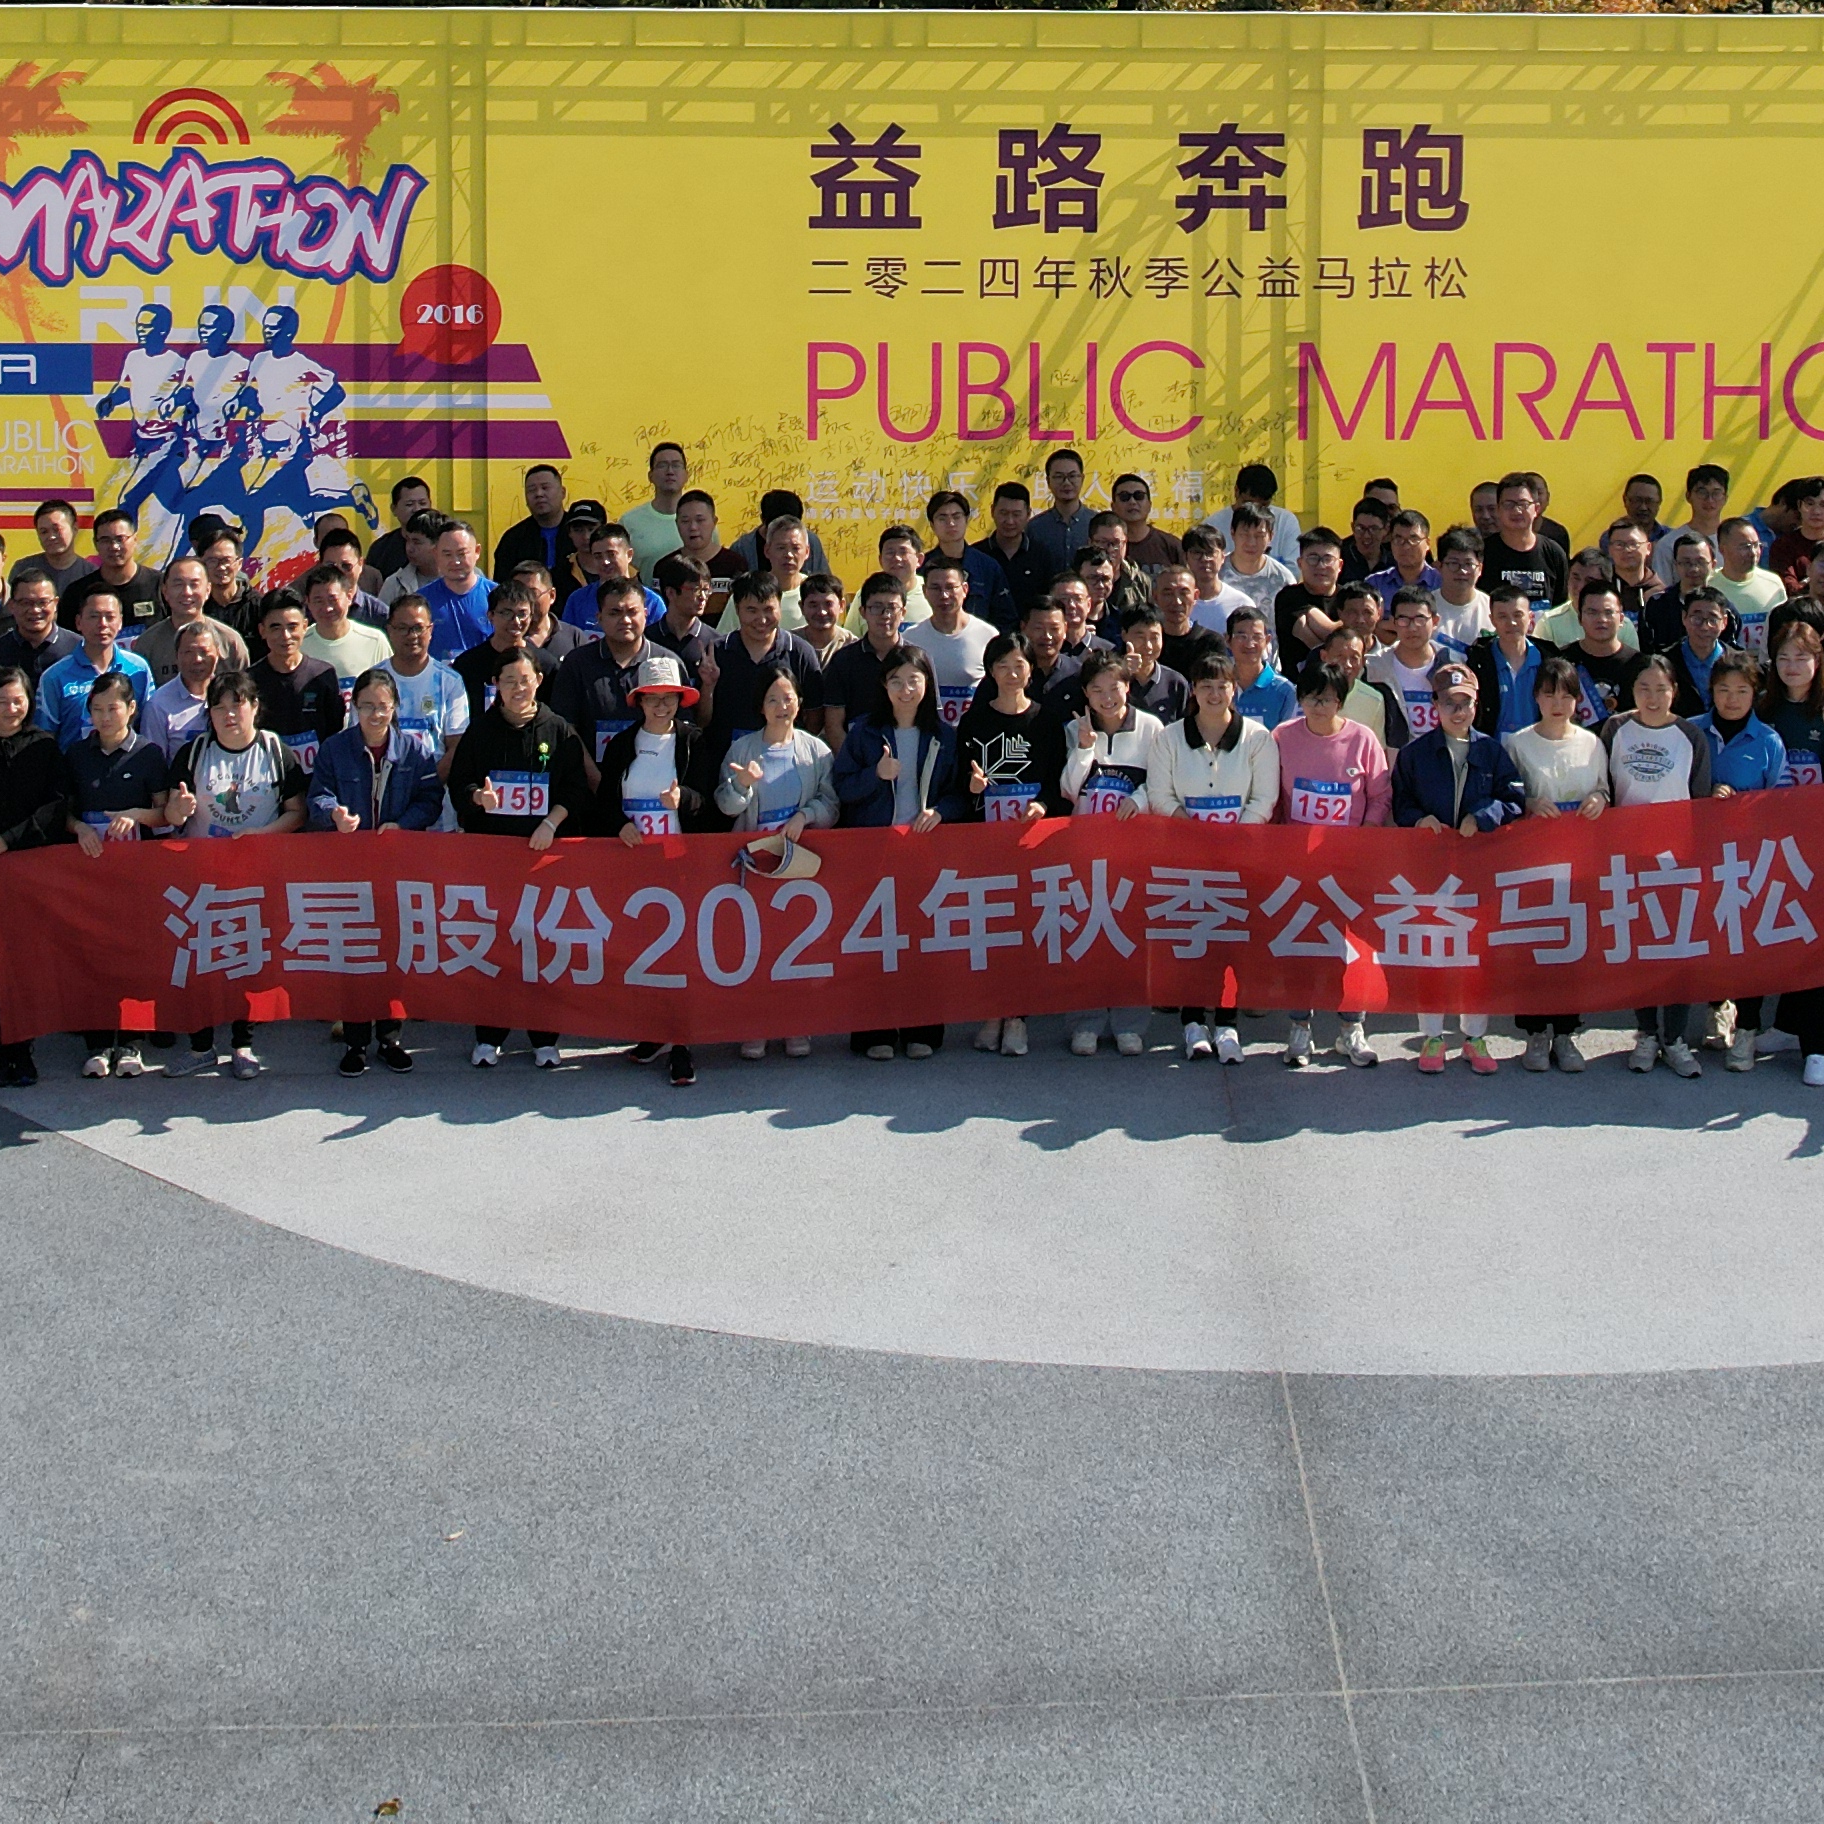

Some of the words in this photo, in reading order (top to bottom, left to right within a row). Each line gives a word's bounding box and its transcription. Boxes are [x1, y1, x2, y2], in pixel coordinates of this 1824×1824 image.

[808, 121, 1470, 234] 益路奔跑
[808, 256, 1468, 299] 二零二四年秋季公益马拉松
[416, 304, 484, 325] 2016
[807, 341, 1205, 442] PUBLIC
[494, 785, 545, 811] 159
[1298, 793, 1348, 822] 152
[163, 835, 1818, 988] 海星股份2024年秋季公益马拉松
